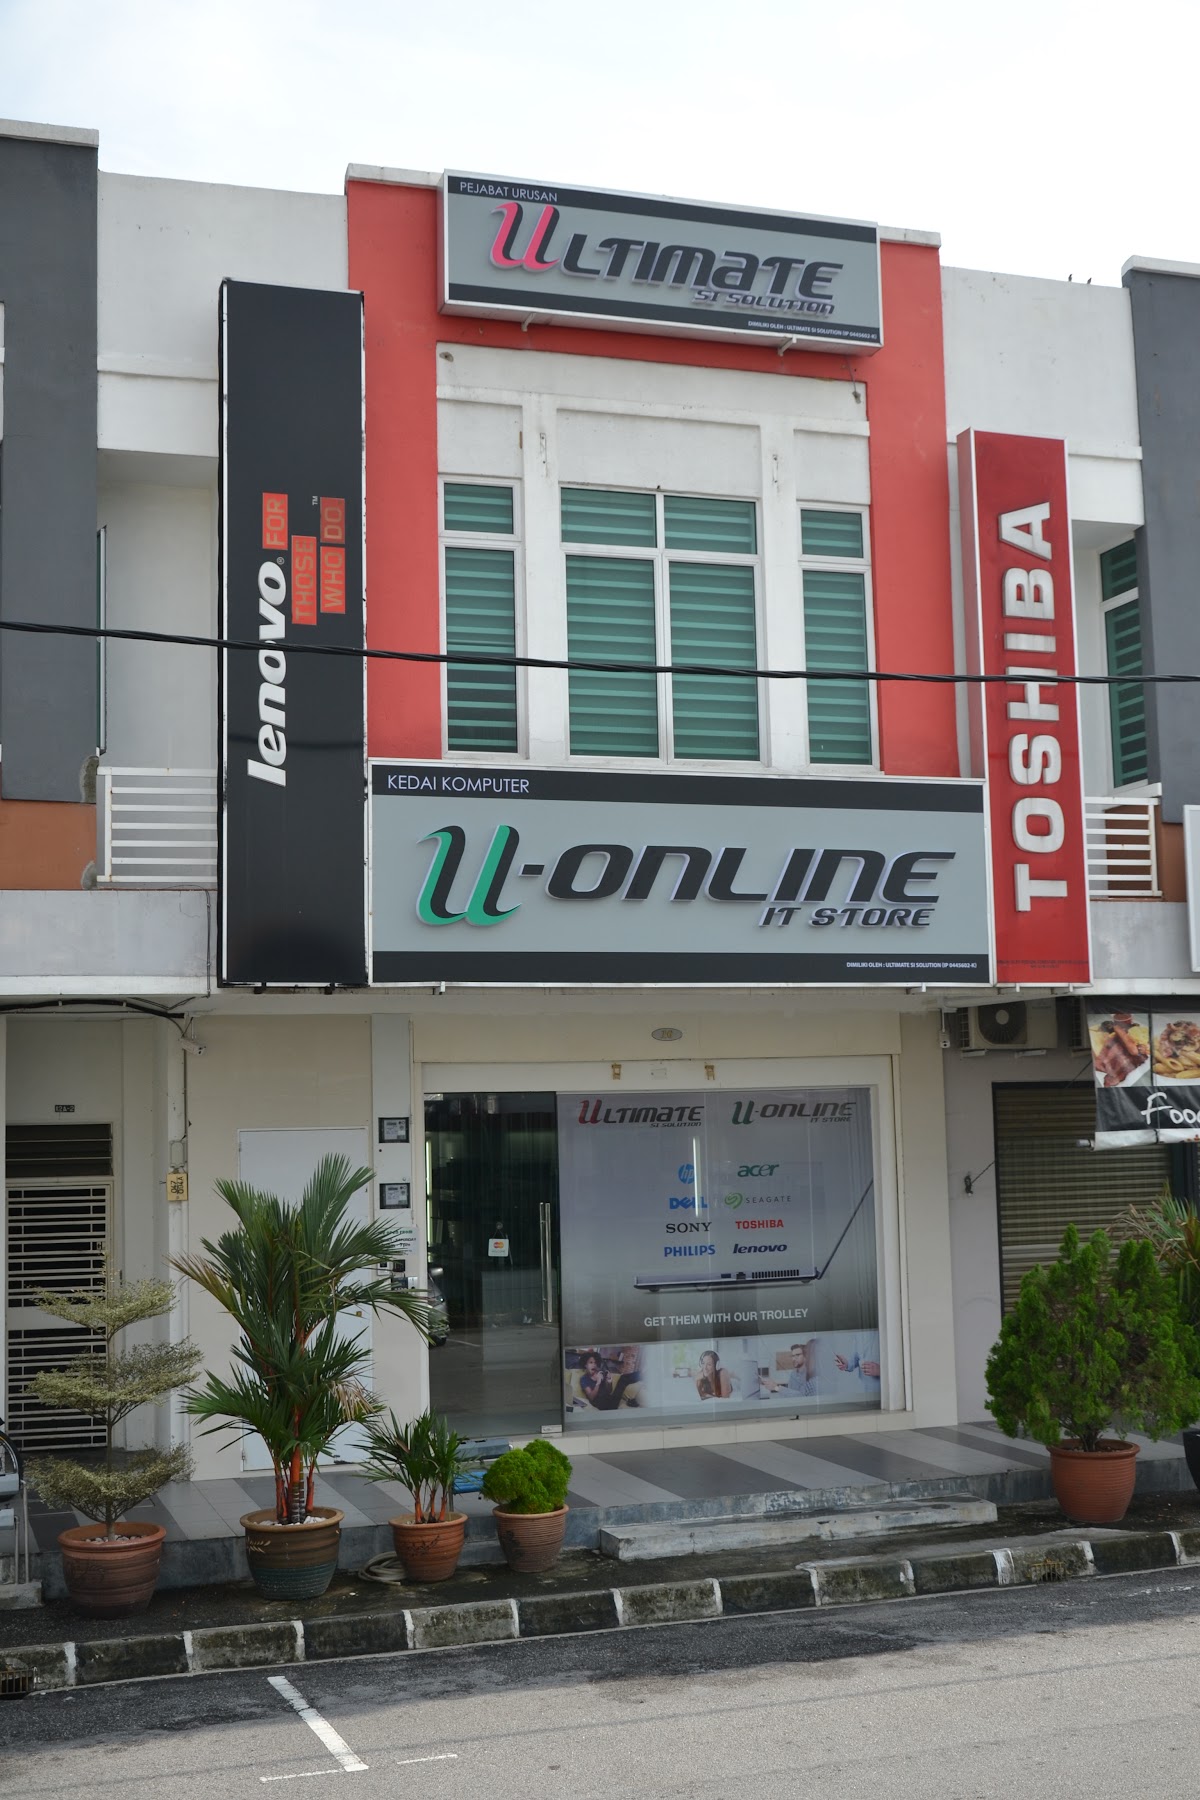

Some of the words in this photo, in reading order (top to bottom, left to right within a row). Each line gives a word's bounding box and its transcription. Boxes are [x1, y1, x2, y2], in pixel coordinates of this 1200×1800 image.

[460, 181, 509, 197] PEJABAT
[511, 188, 558, 202] URUSAN
[693, 290, 720, 304] SI
[724, 293, 836, 316] SOLUTION
[787, 325, 812, 333] ULTIMATE
[816, 328, 842, 336] SOLUTION
[265, 498, 285, 546] FOR
[295, 540, 314, 620] THOSE
[324, 552, 343, 608] WHO
[247, 561, 287, 787] lenovo
[999, 501, 1068, 912] TOSHIBA
[387, 774, 437, 790] KEDAI
[442, 776, 530, 793] KOMPUTER
[416, 824, 957, 926] U-ONLINE
[760, 906, 802, 928] IT
[810, 906, 936, 928] STORE
[731, 1100, 857, 1125] U-ONLINE
[737, 1163, 780, 1178] acer
[745, 1195, 792, 1204] SEAGATE
[665, 1221, 713, 1234] SONY
[735, 1219, 784, 1230] TOSHIBA
[663, 1244, 716, 1257] PHILIPS
[732, 1243, 788, 1254] lenovo
[643, 1316, 666, 1327] GET
[668, 1315, 700, 1326] THEM
[702, 1312, 731, 1324] WITH
[733, 1311, 758, 1322] OUR
[760, 1308, 809, 1321] TROLLEY
